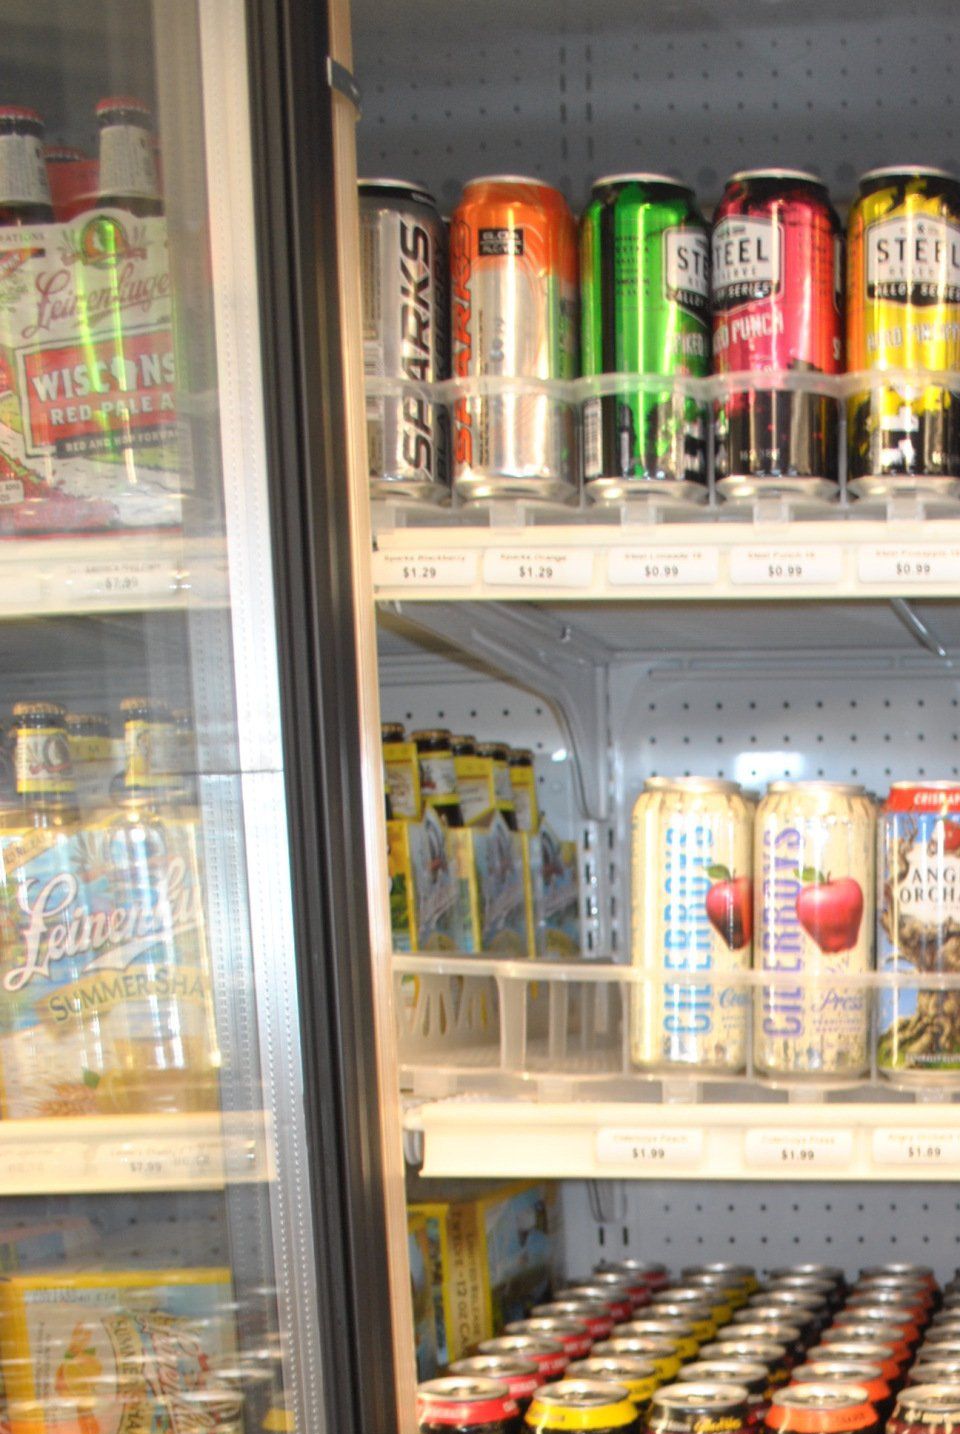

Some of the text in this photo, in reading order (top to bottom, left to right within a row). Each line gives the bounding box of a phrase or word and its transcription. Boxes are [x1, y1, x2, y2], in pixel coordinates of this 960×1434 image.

[877, 238, 960, 269] STEEL
[731, 309, 784, 344] PUNCH
[400, 215, 434, 481] SPARKS
[50, 406, 92, 426] RED
[404, 567, 437, 578] $1.29
[520, 566, 553, 578] $1.29
[645, 566, 679, 578] $0.99
[769, 566, 803, 578] $0.99
[896, 562, 931, 575] $0.99
[49, 965, 205, 1023] SUMMER SHA
[632, 1148, 665, 1159] $1.99
[782, 1150, 815, 1161] $1.99
